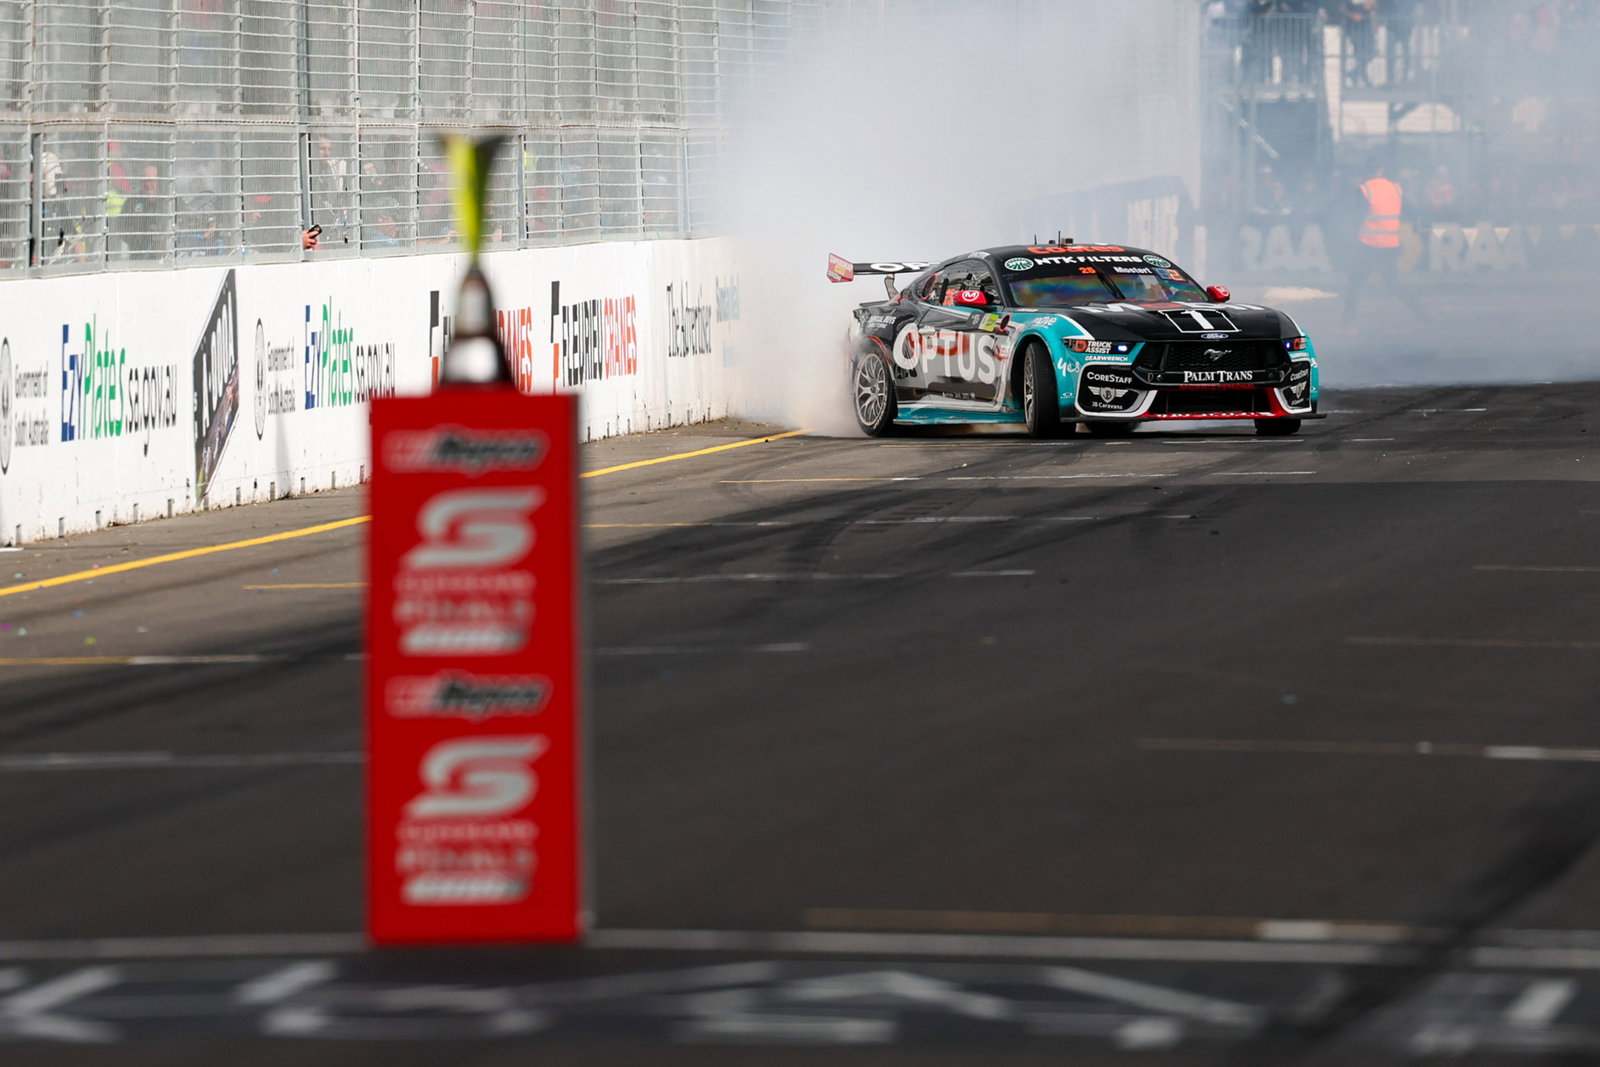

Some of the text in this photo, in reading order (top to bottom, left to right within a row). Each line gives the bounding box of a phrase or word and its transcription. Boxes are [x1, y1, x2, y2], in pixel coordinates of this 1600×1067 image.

[1034, 255, 1143, 265] NTK FILTERS
[1114, 266, 1152, 274] Mostert
[1181, 309, 1215, 330] 1
[893, 323, 996, 384] OPTUS
[1057, 357, 1081, 376] yes
[1183, 371, 1253, 383] PALM TRANS
[1099, 402, 1123, 410] Caravans
